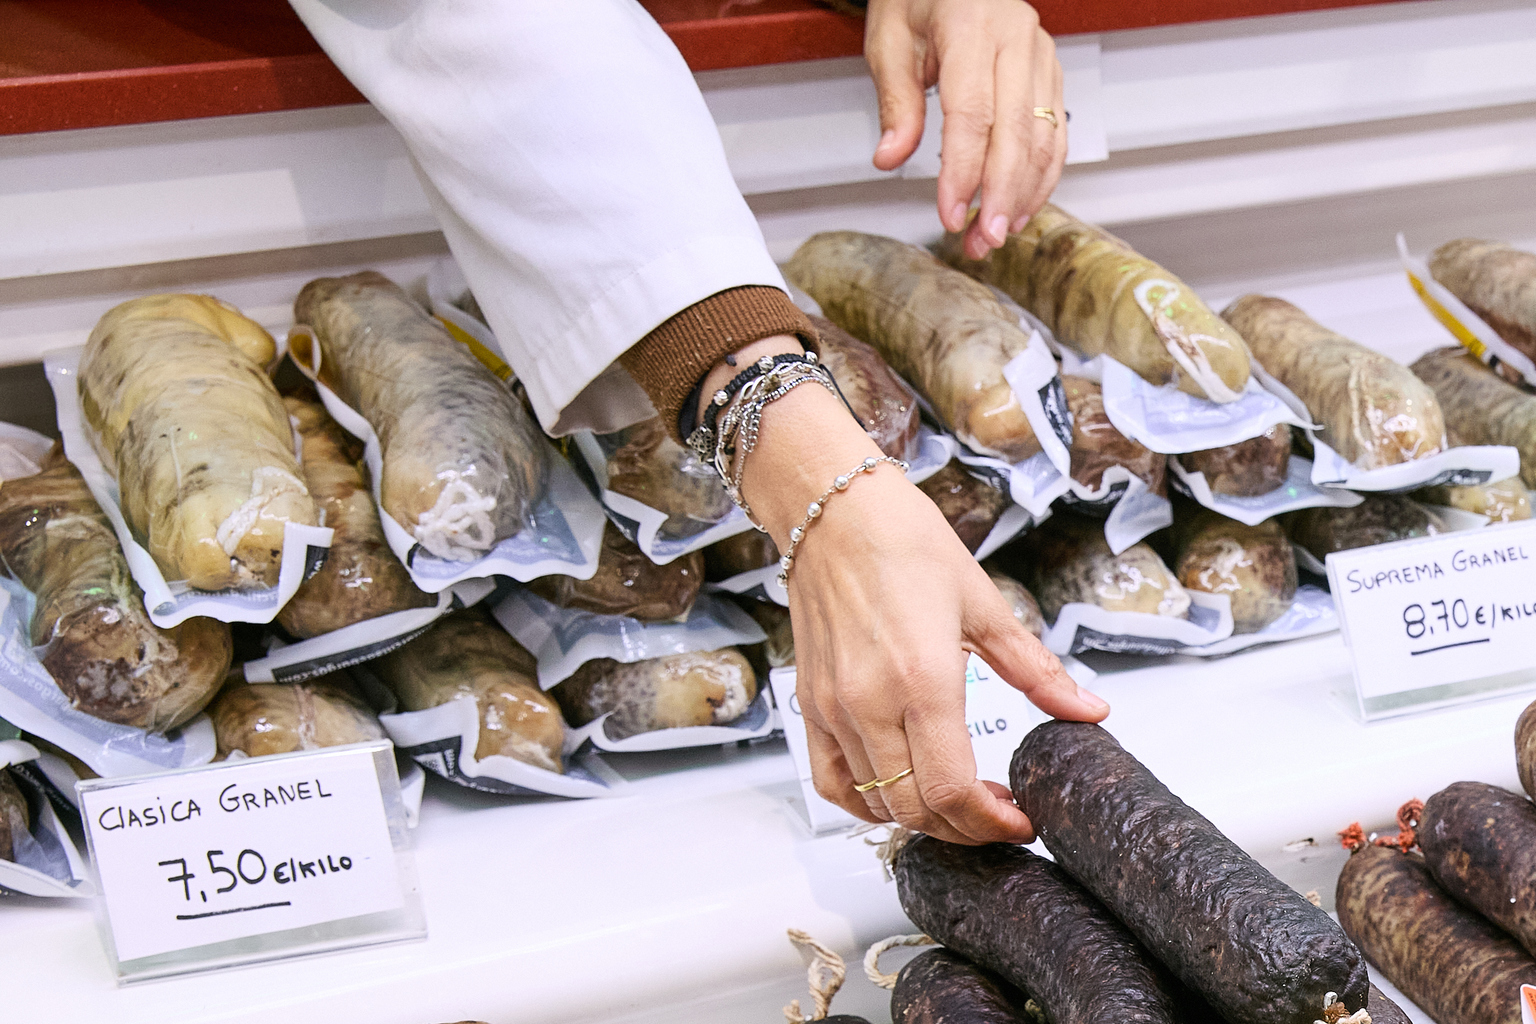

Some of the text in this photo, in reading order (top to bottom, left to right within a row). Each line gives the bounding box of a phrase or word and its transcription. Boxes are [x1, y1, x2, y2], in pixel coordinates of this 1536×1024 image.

[1347, 546, 1528, 593] SUPREMA GRANEL
[219, 779, 332, 812] GRANEL
